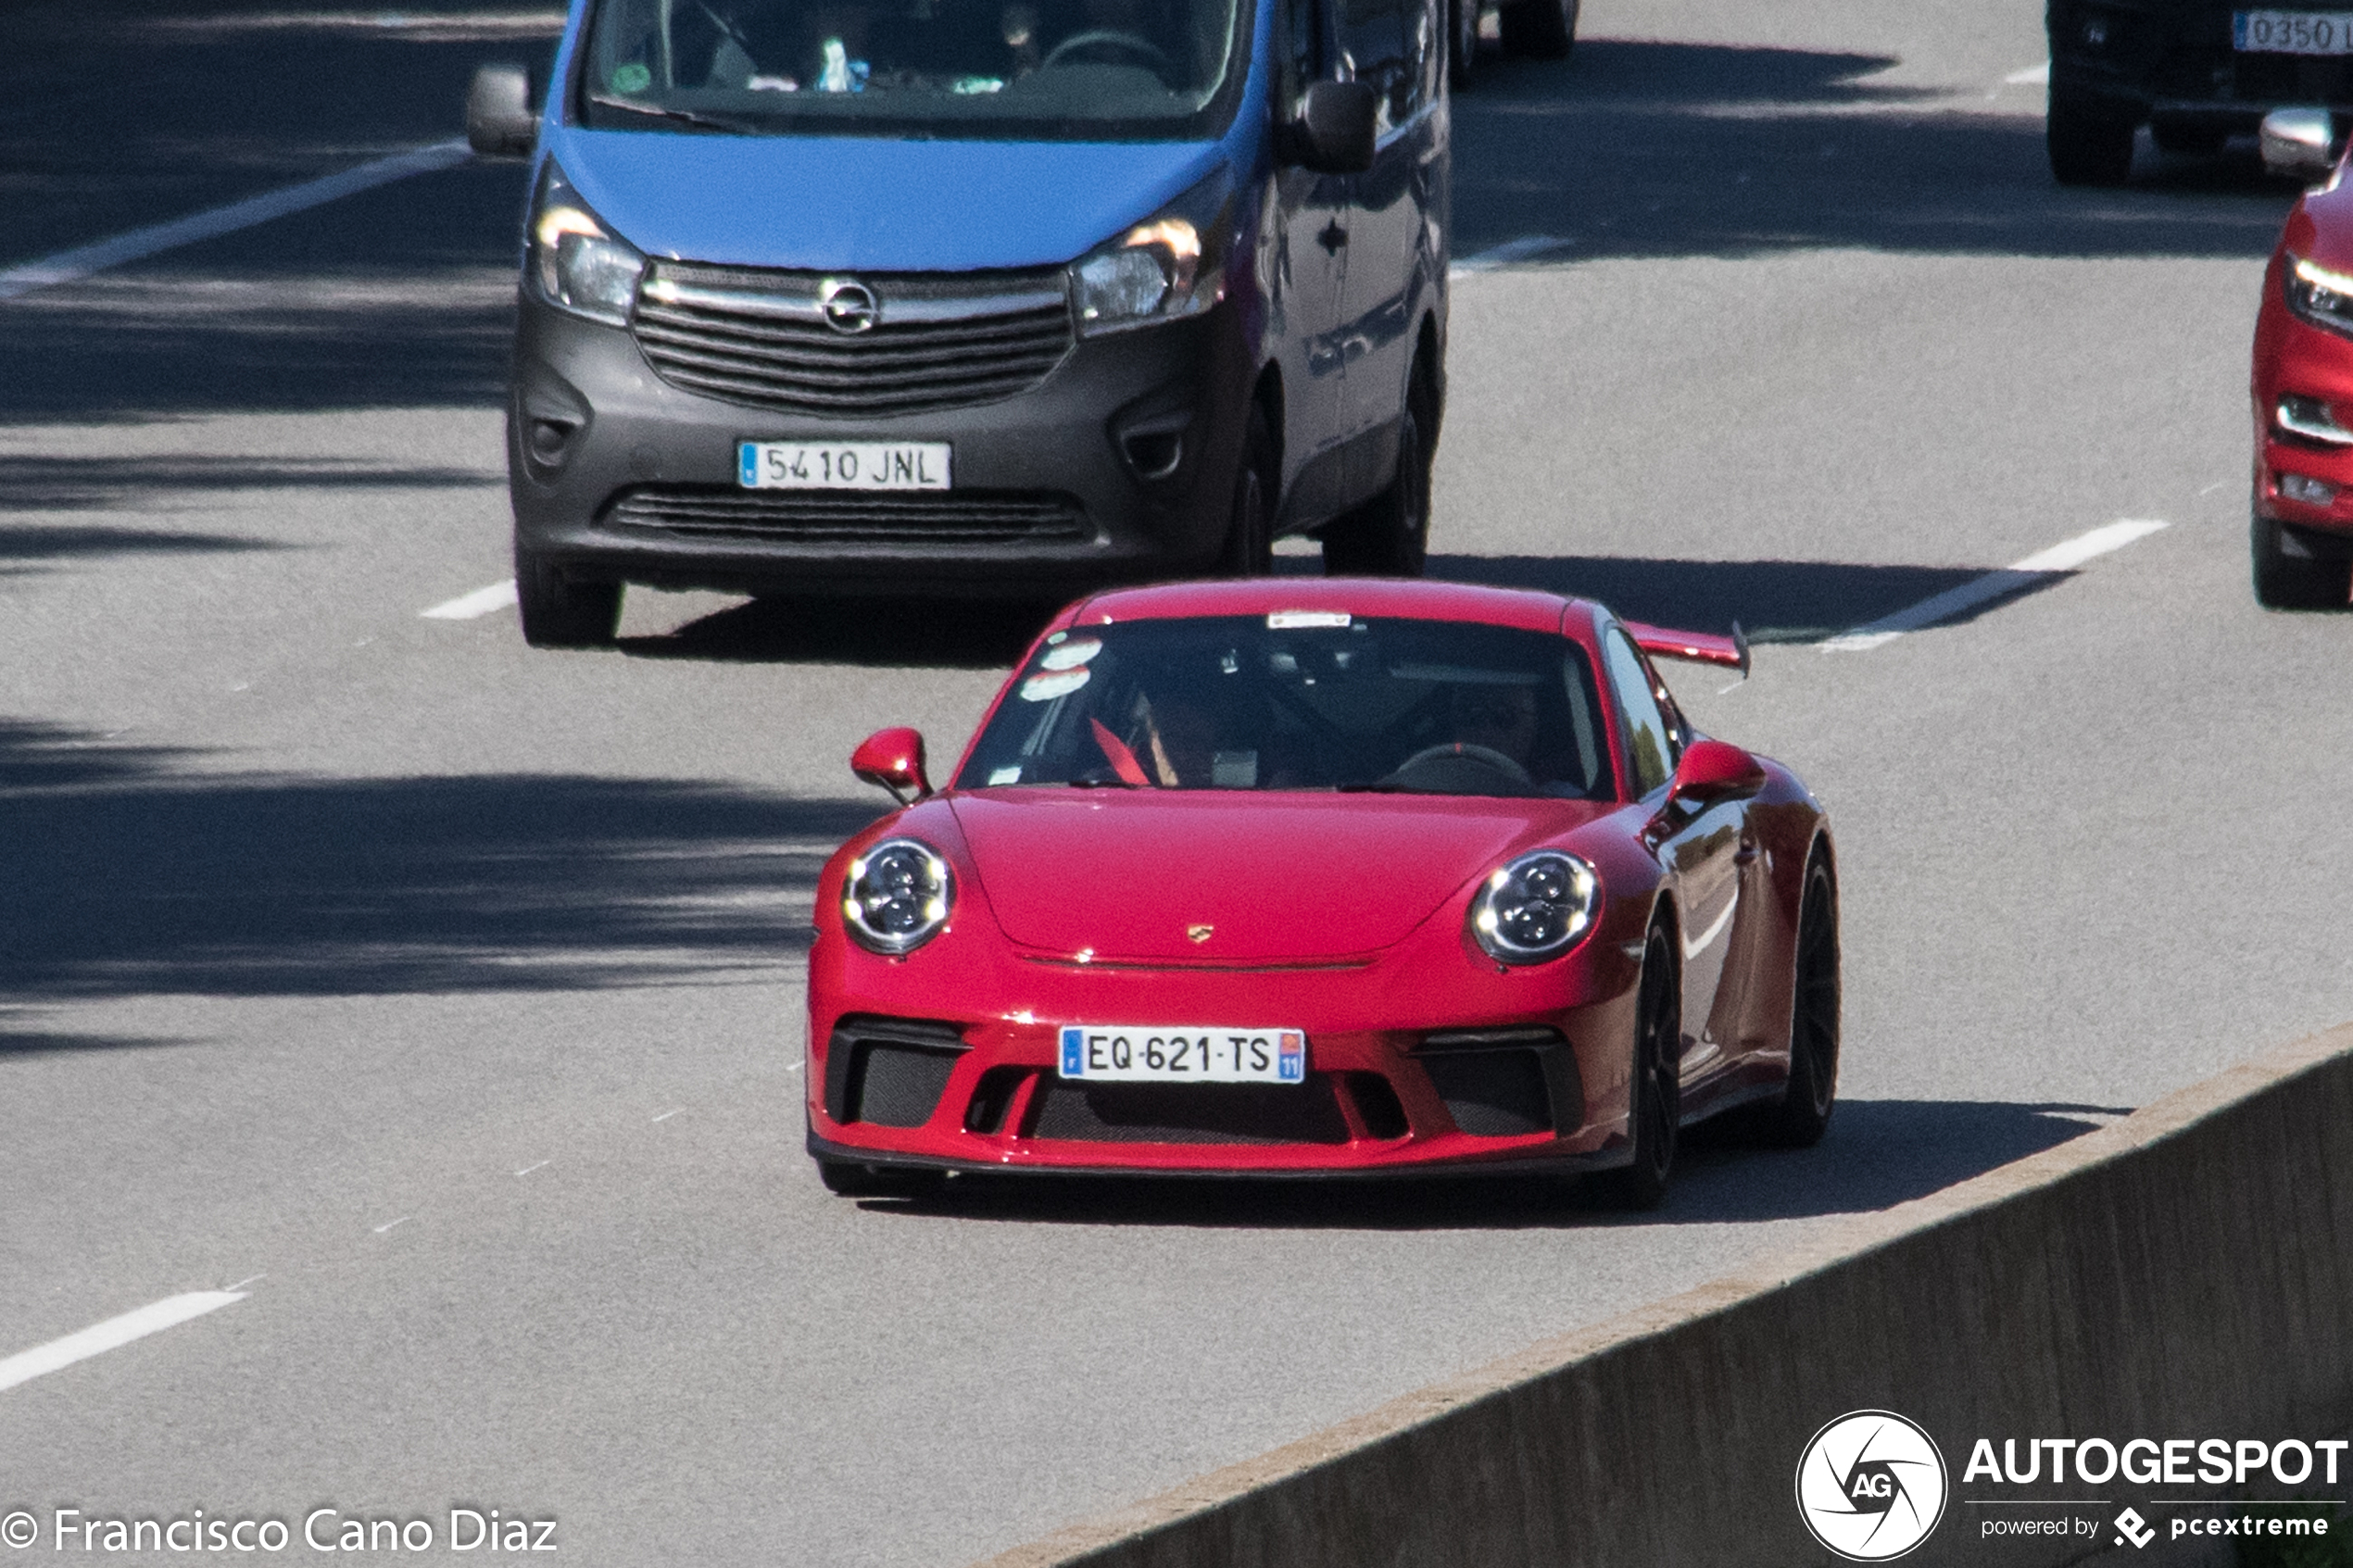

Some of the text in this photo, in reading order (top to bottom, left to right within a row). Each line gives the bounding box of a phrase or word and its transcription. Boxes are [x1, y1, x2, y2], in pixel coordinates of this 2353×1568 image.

[2254, 19, 2333, 49] 0350
[768, 449, 937, 483] 5410 JNL
[1282, 1057, 1299, 1075] 11
